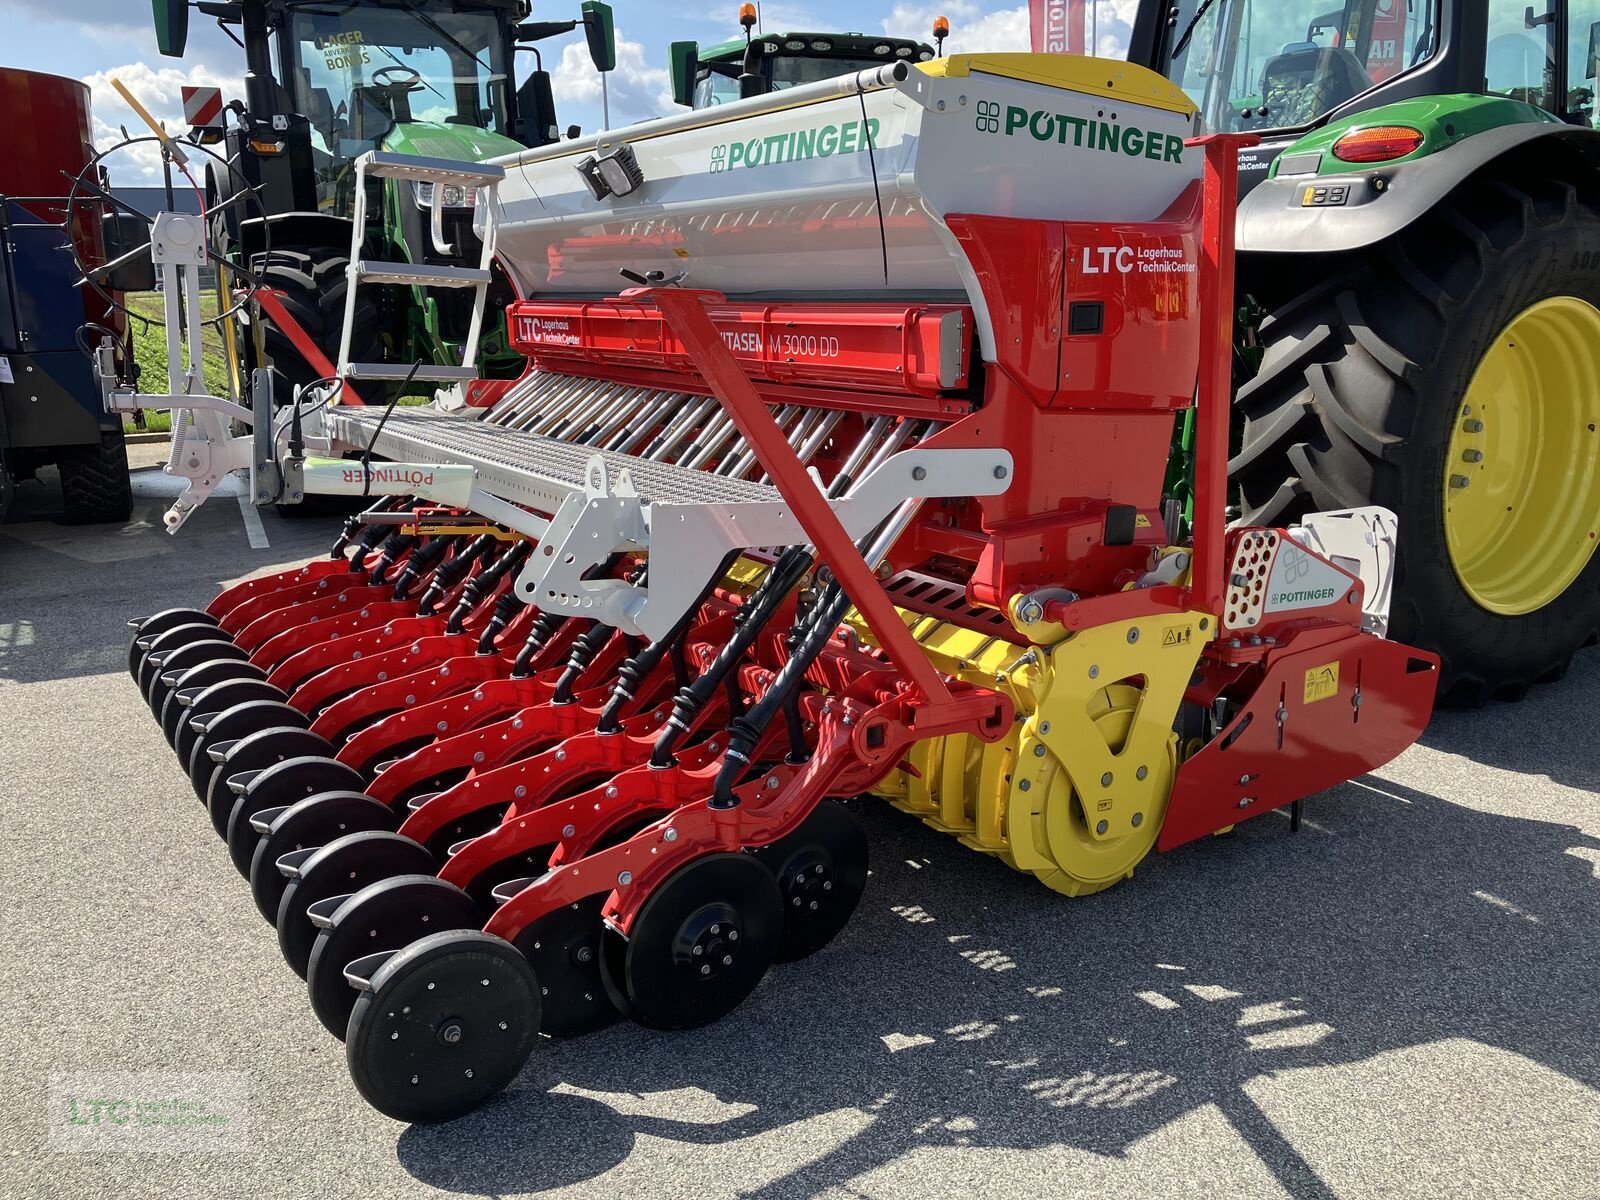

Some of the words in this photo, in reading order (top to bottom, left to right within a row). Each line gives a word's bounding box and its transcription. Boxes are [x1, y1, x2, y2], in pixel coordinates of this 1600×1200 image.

[319, 30, 364, 49] LAGER
[727, 117, 880, 171] PÖTTINGER
[1005, 105, 1184, 164] PÖTTINGER
[1082, 246, 1134, 274] LTC
[1137, 246, 1183, 260] Lagerhaus
[1137, 261, 1196, 273] TechnikCenter
[518, 317, 541, 342] LTC
[541, 318, 569, 331] Lagerhaus
[542, 332, 580, 345] TechnikCenter
[769, 334, 780, 354] M
[783, 335, 817, 356] 3000
[820, 336, 839, 357] DD
